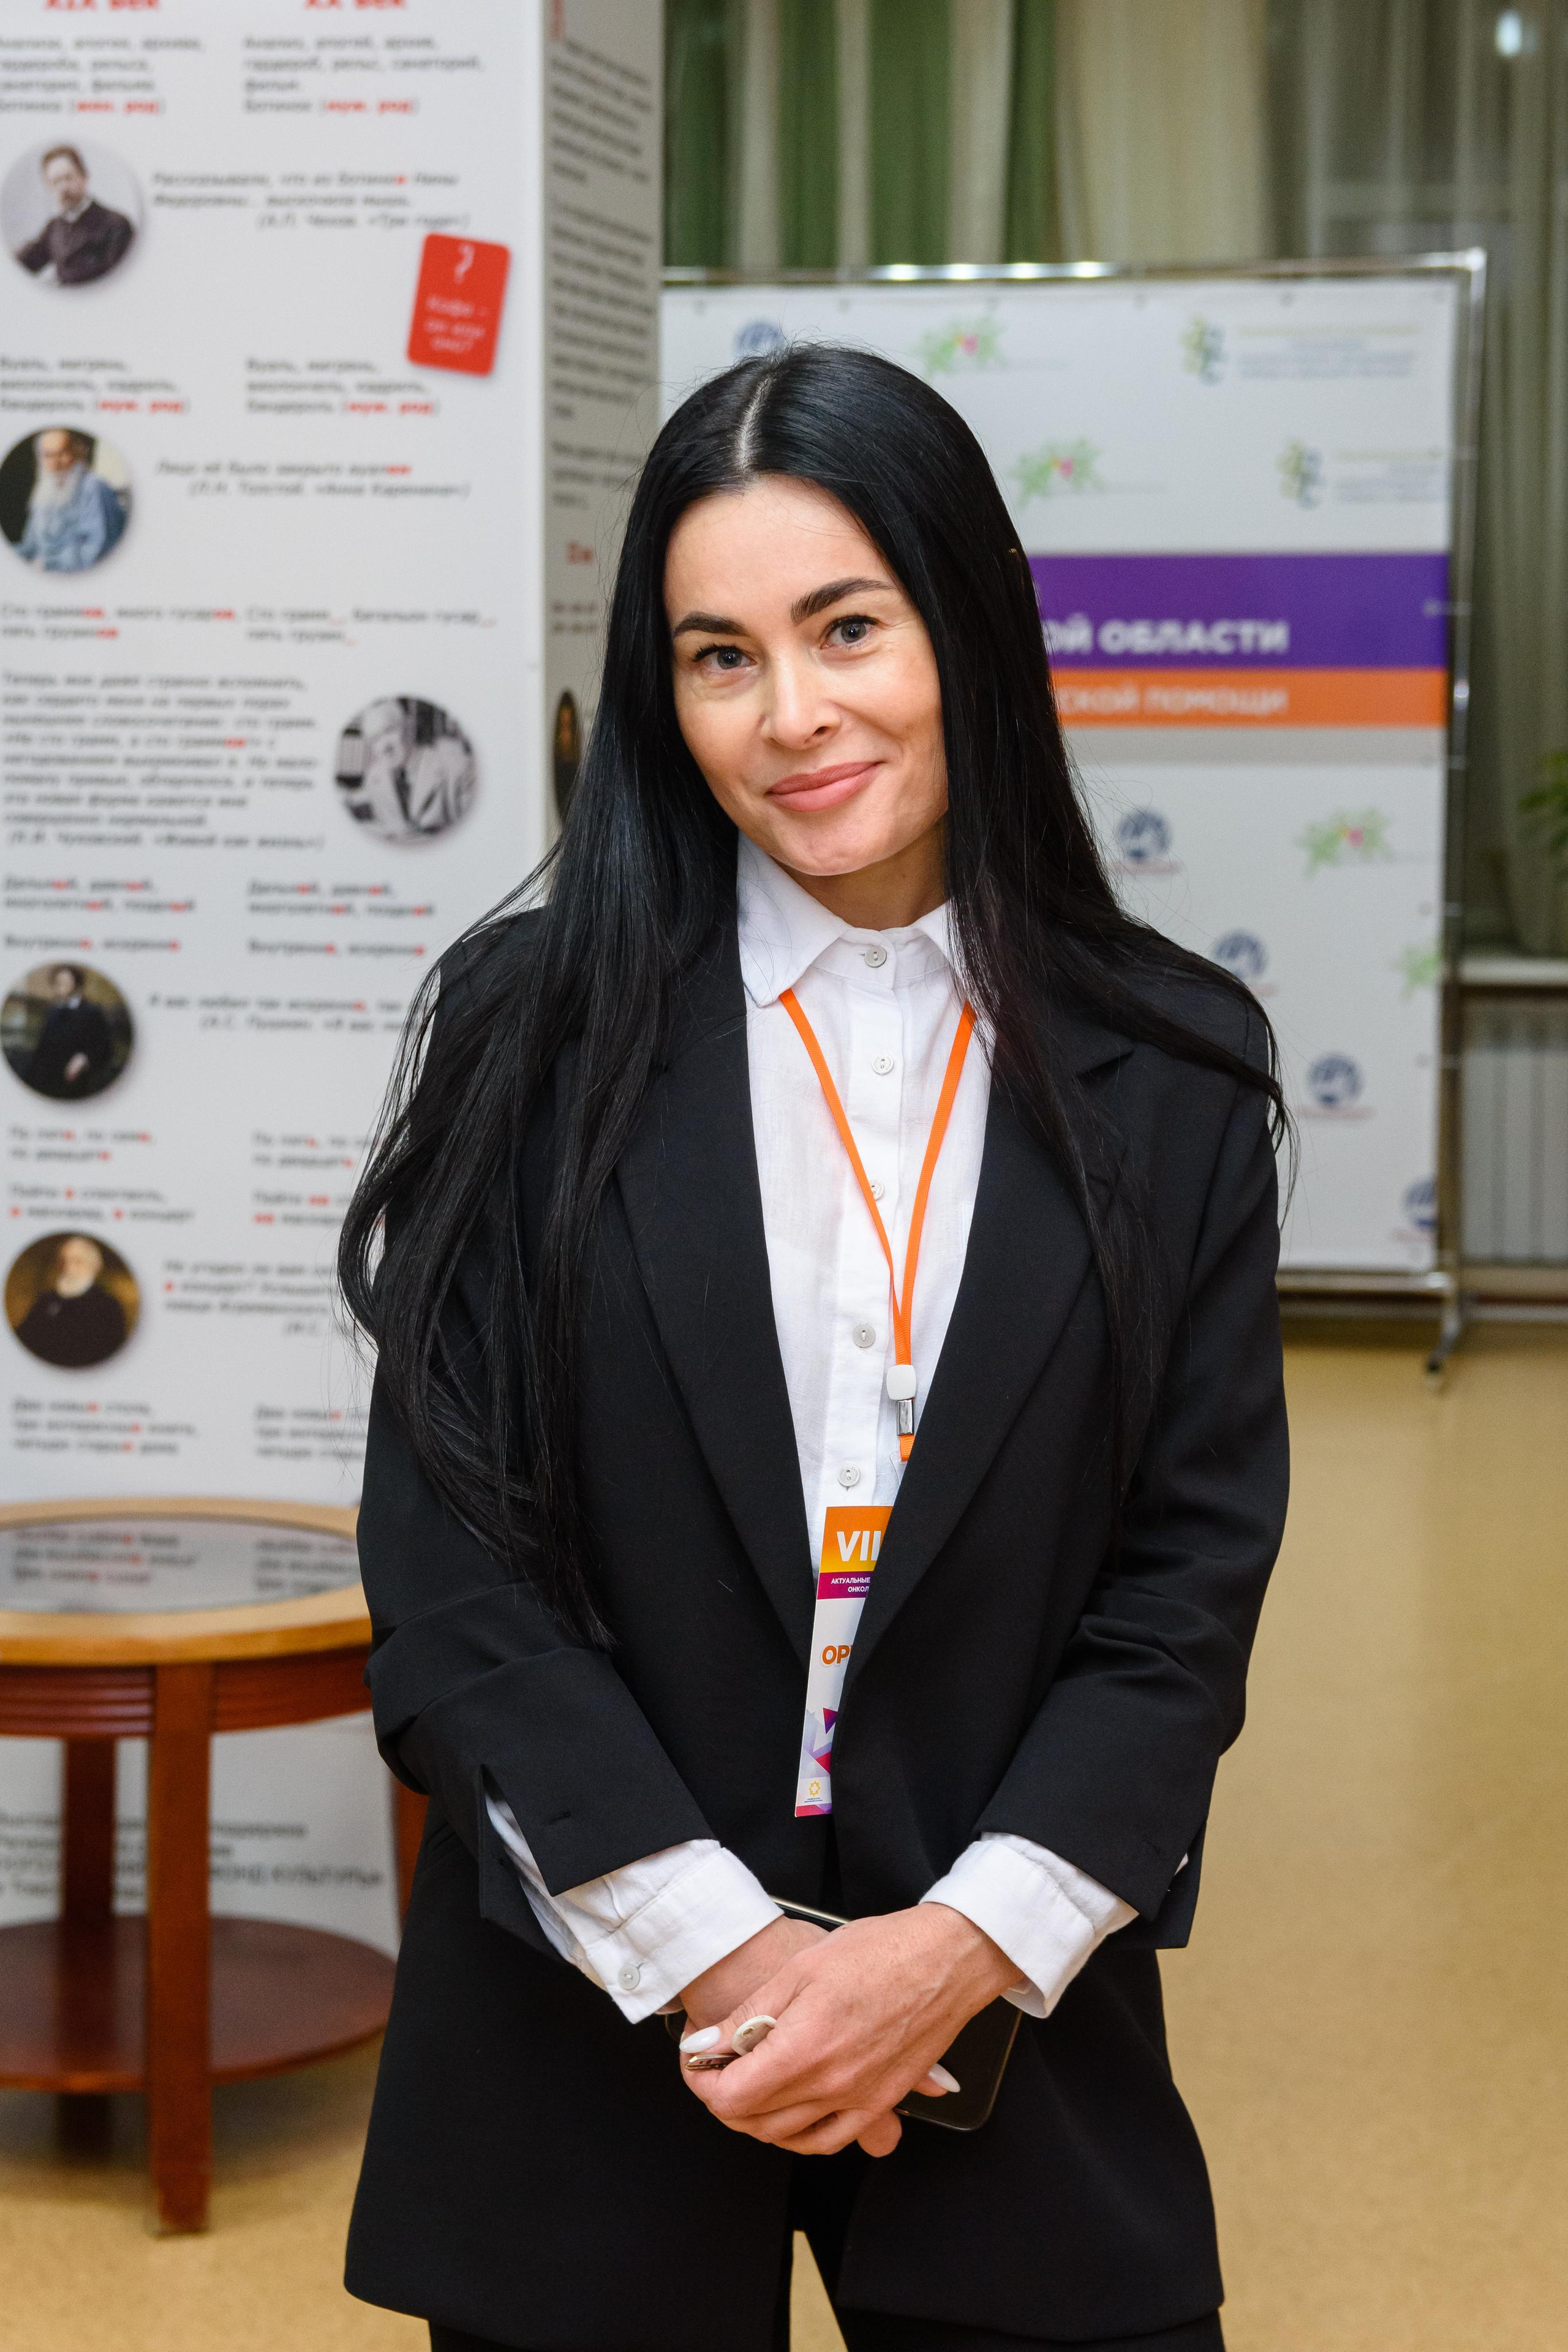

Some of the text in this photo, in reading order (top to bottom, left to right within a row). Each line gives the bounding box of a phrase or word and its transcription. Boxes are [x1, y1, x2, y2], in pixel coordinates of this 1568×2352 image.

[1100, 618, 1289, 655] ОБЛАСТИ
[1144, 685, 1289, 718] ПОМОЩИ
[836, 1531, 882, 1562] VII
[821, 1644, 854, 1665] ОР
